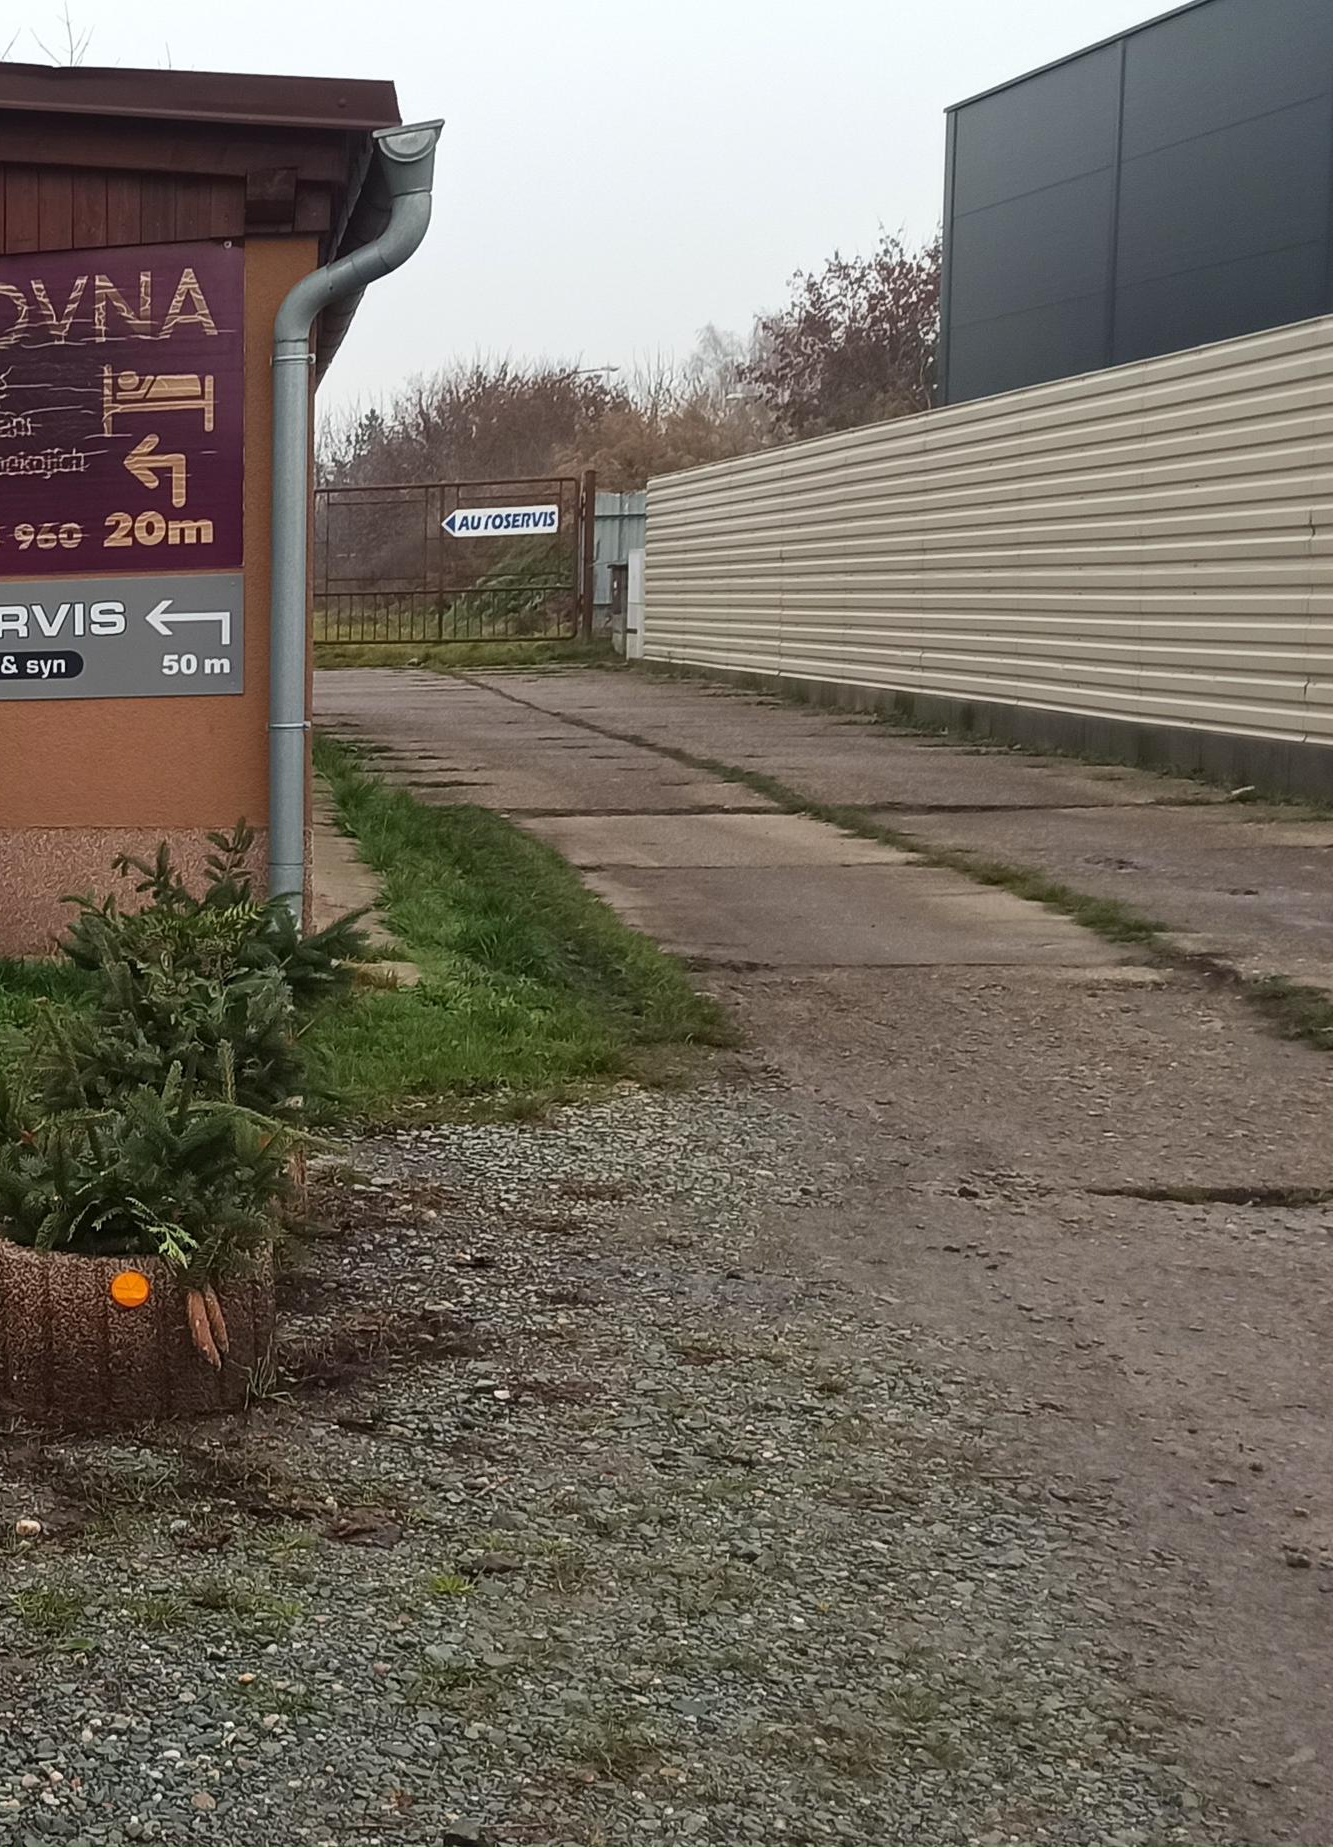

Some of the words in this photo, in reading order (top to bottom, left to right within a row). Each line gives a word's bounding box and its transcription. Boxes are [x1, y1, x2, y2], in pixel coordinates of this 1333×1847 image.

[103, 510, 214, 548] 20m
[457, 511, 556, 531] AUTOSERVIS
[14, 522, 83, 550] 960
[0, 655, 19, 673] &
[26, 657, 67, 676] syn
[161, 654, 197, 676] 50
[204, 657, 231, 675] m
